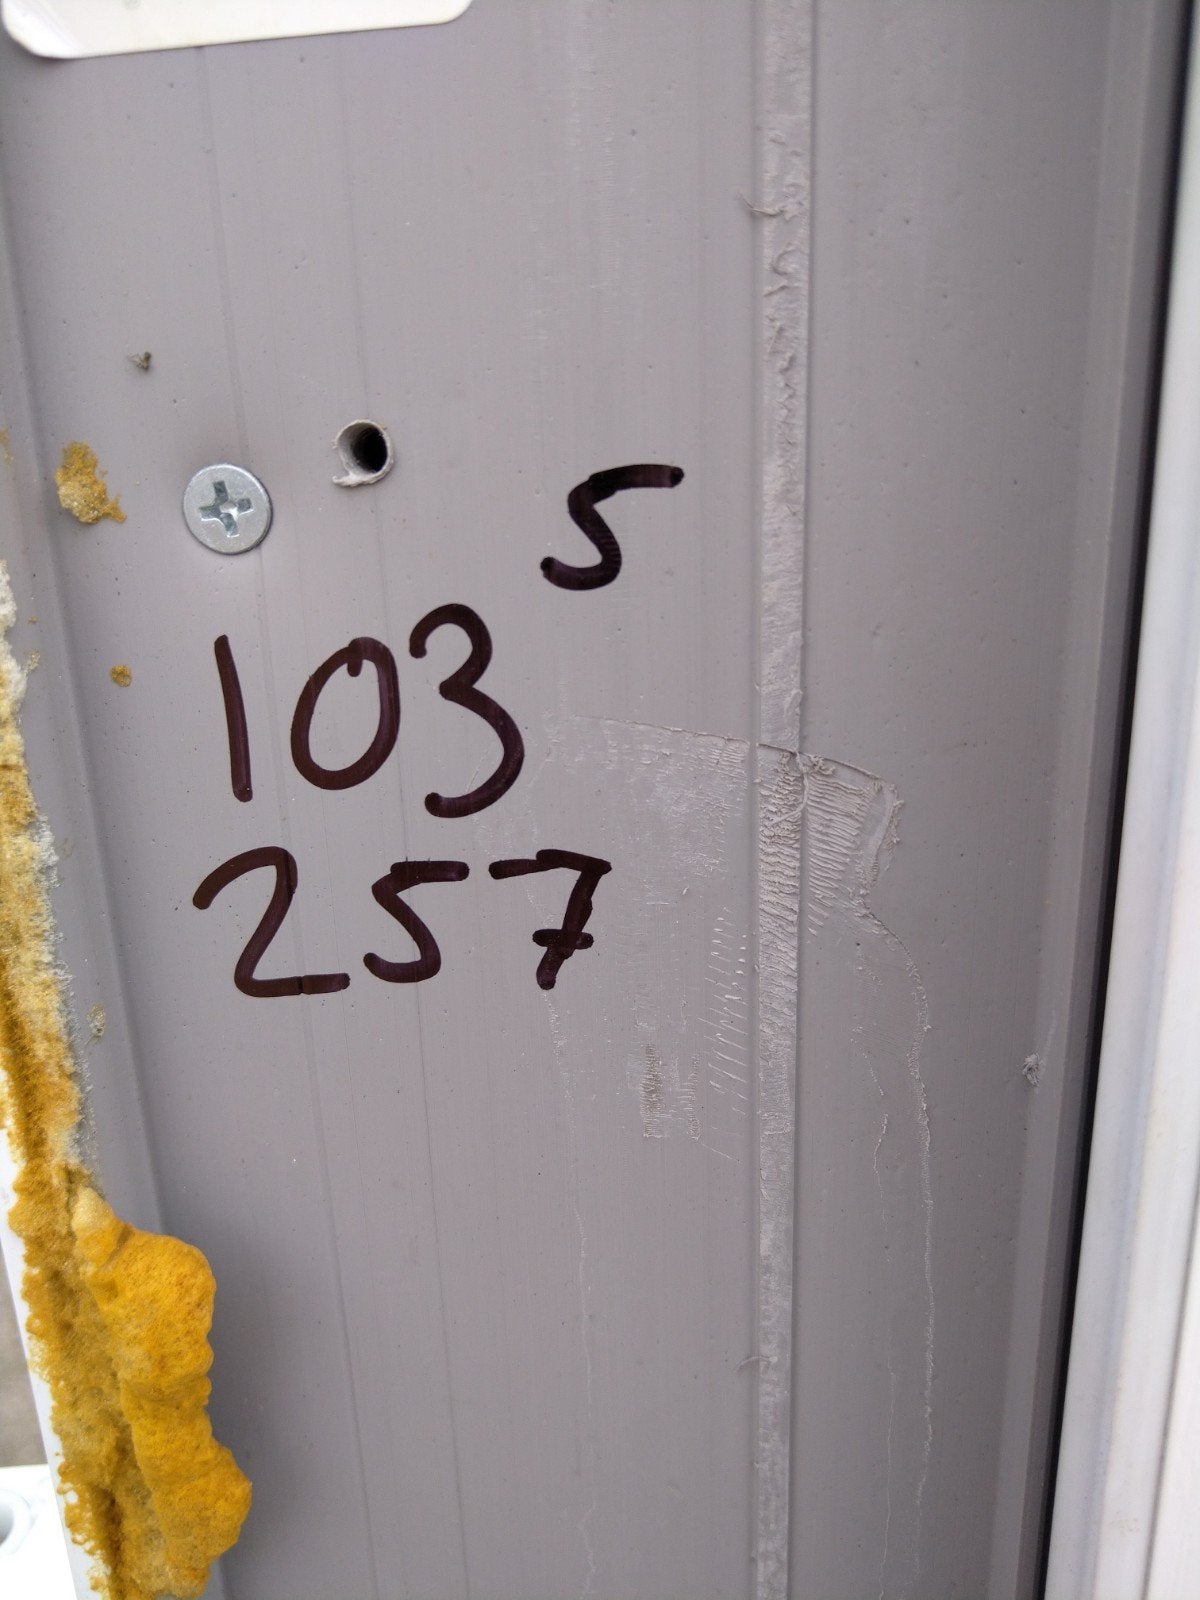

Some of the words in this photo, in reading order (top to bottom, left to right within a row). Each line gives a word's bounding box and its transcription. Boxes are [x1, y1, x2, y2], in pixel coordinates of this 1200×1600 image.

[540, 463, 685, 591] 5
[213, 603, 525, 819] 103
[192, 846, 613, 998] 257
